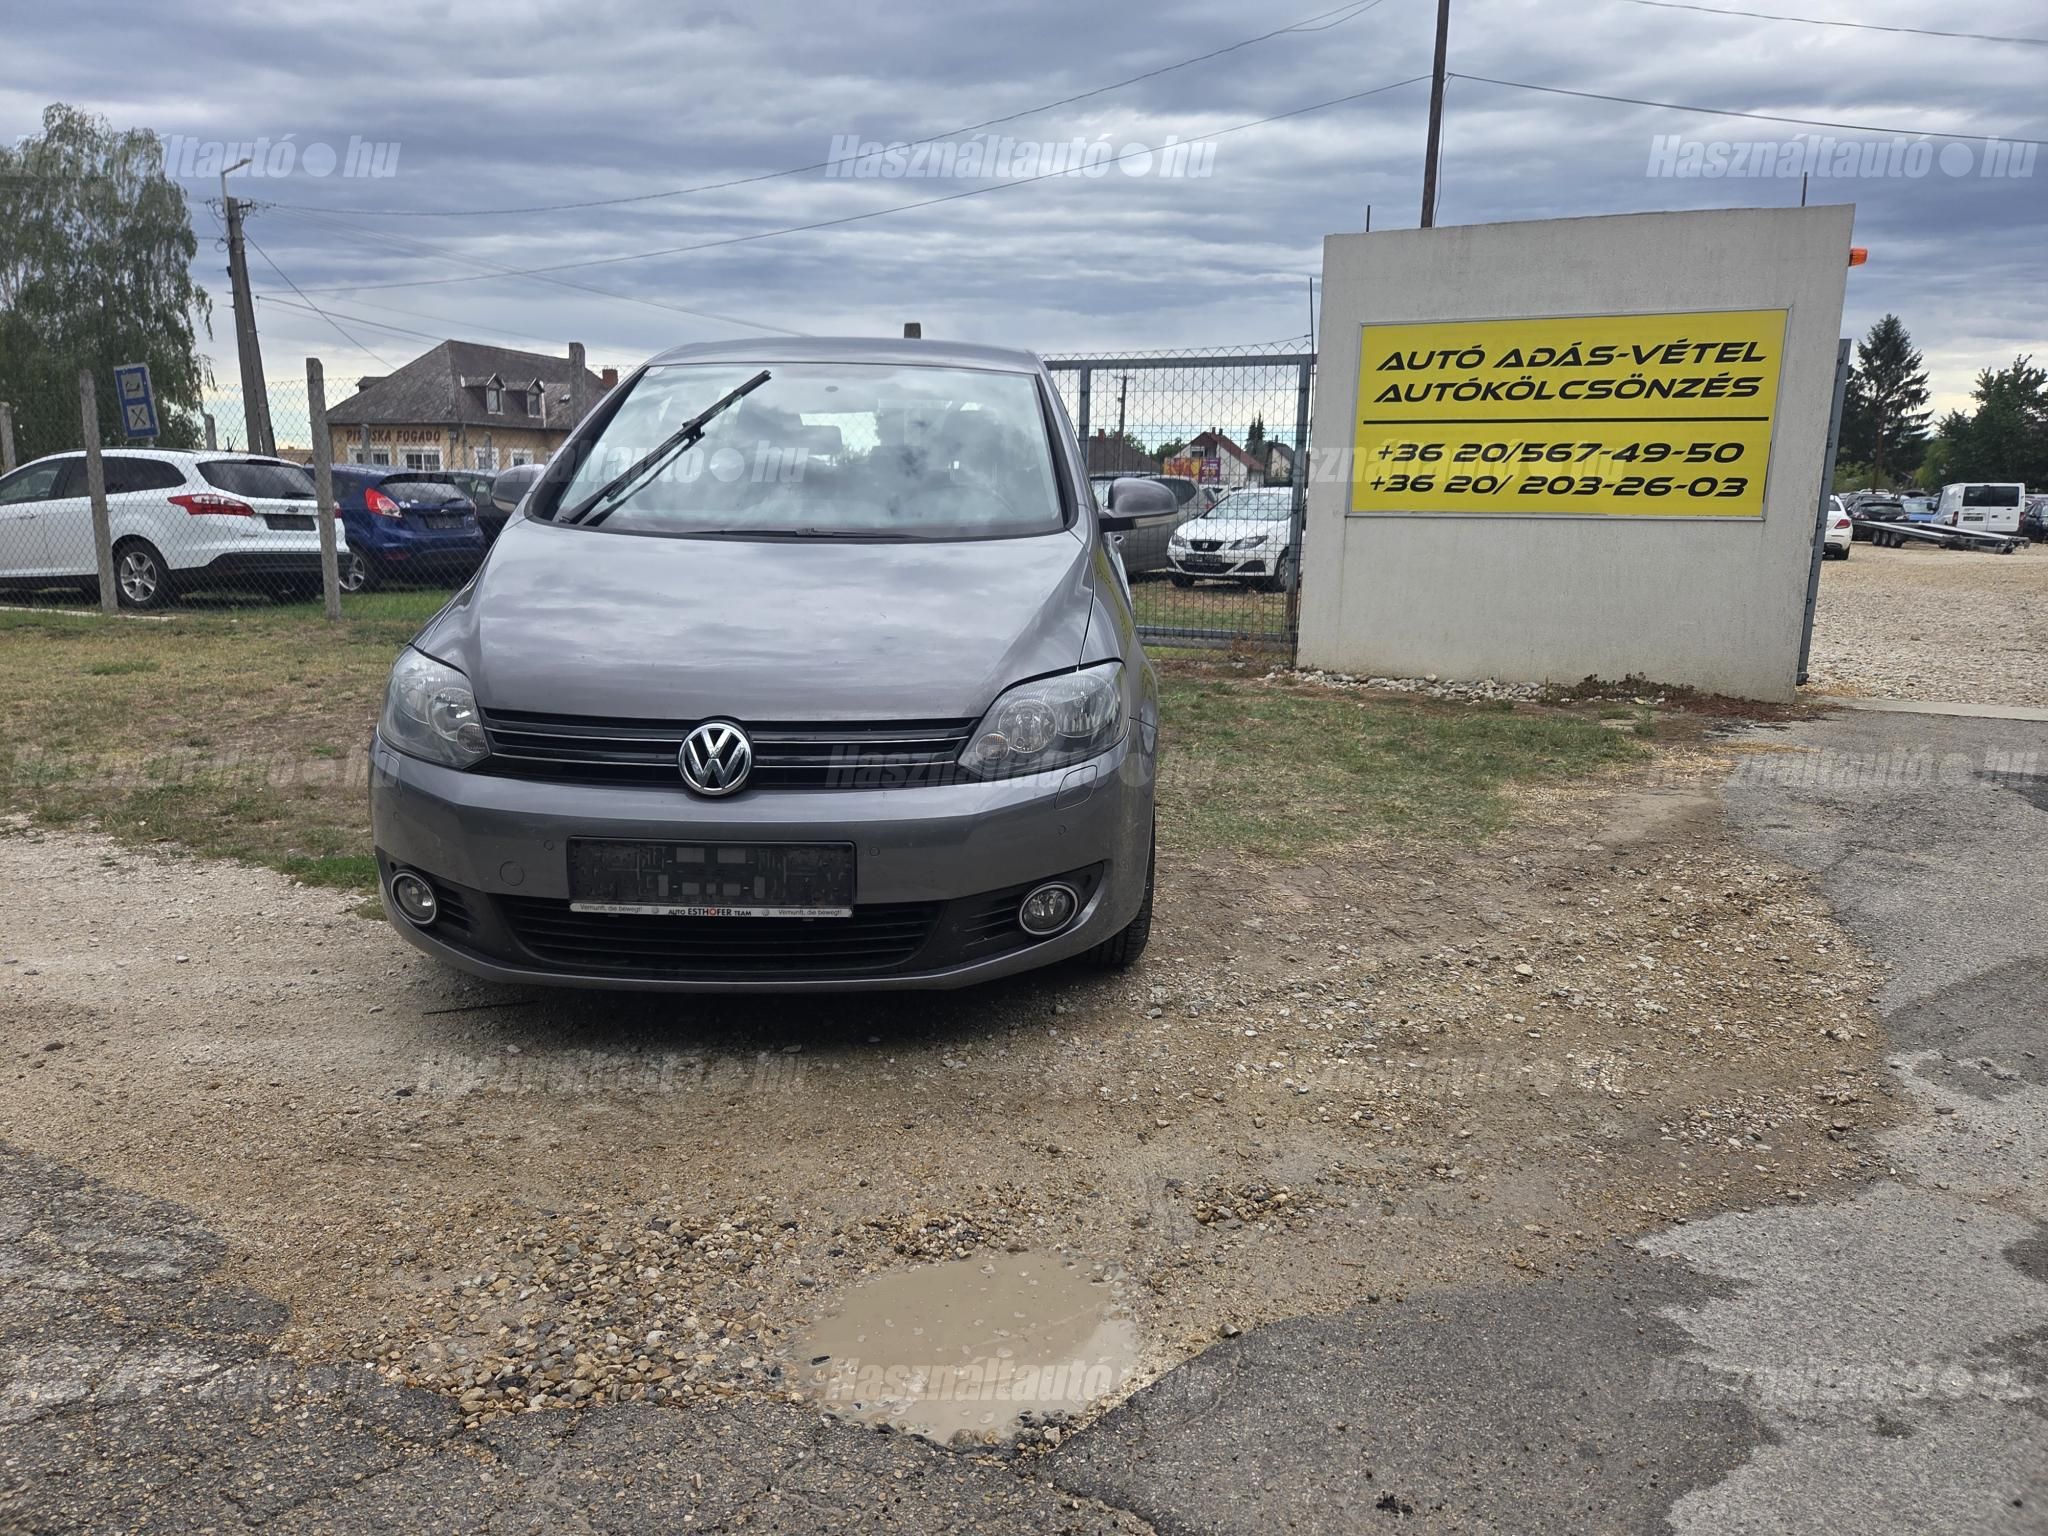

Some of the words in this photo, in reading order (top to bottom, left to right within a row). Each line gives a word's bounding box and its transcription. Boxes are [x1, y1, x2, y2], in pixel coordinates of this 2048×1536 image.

[1376, 344, 1486, 371] AUTÓ
[1493, 338, 1767, 369] ADÁS-VÉTEL
[1373, 372, 1765, 403] AUTÓKÖLCSÖNZÉS
[1377, 443, 1446, 464] +36
[1453, 442, 1746, 465] 20/567-49-50
[1370, 475, 1436, 494] +36
[1444, 475, 1514, 495] 20/
[1518, 476, 1750, 498] 203-26-03
[681, 725, 749, 791] VW
[687, 907, 732, 917] ESTHOFER
